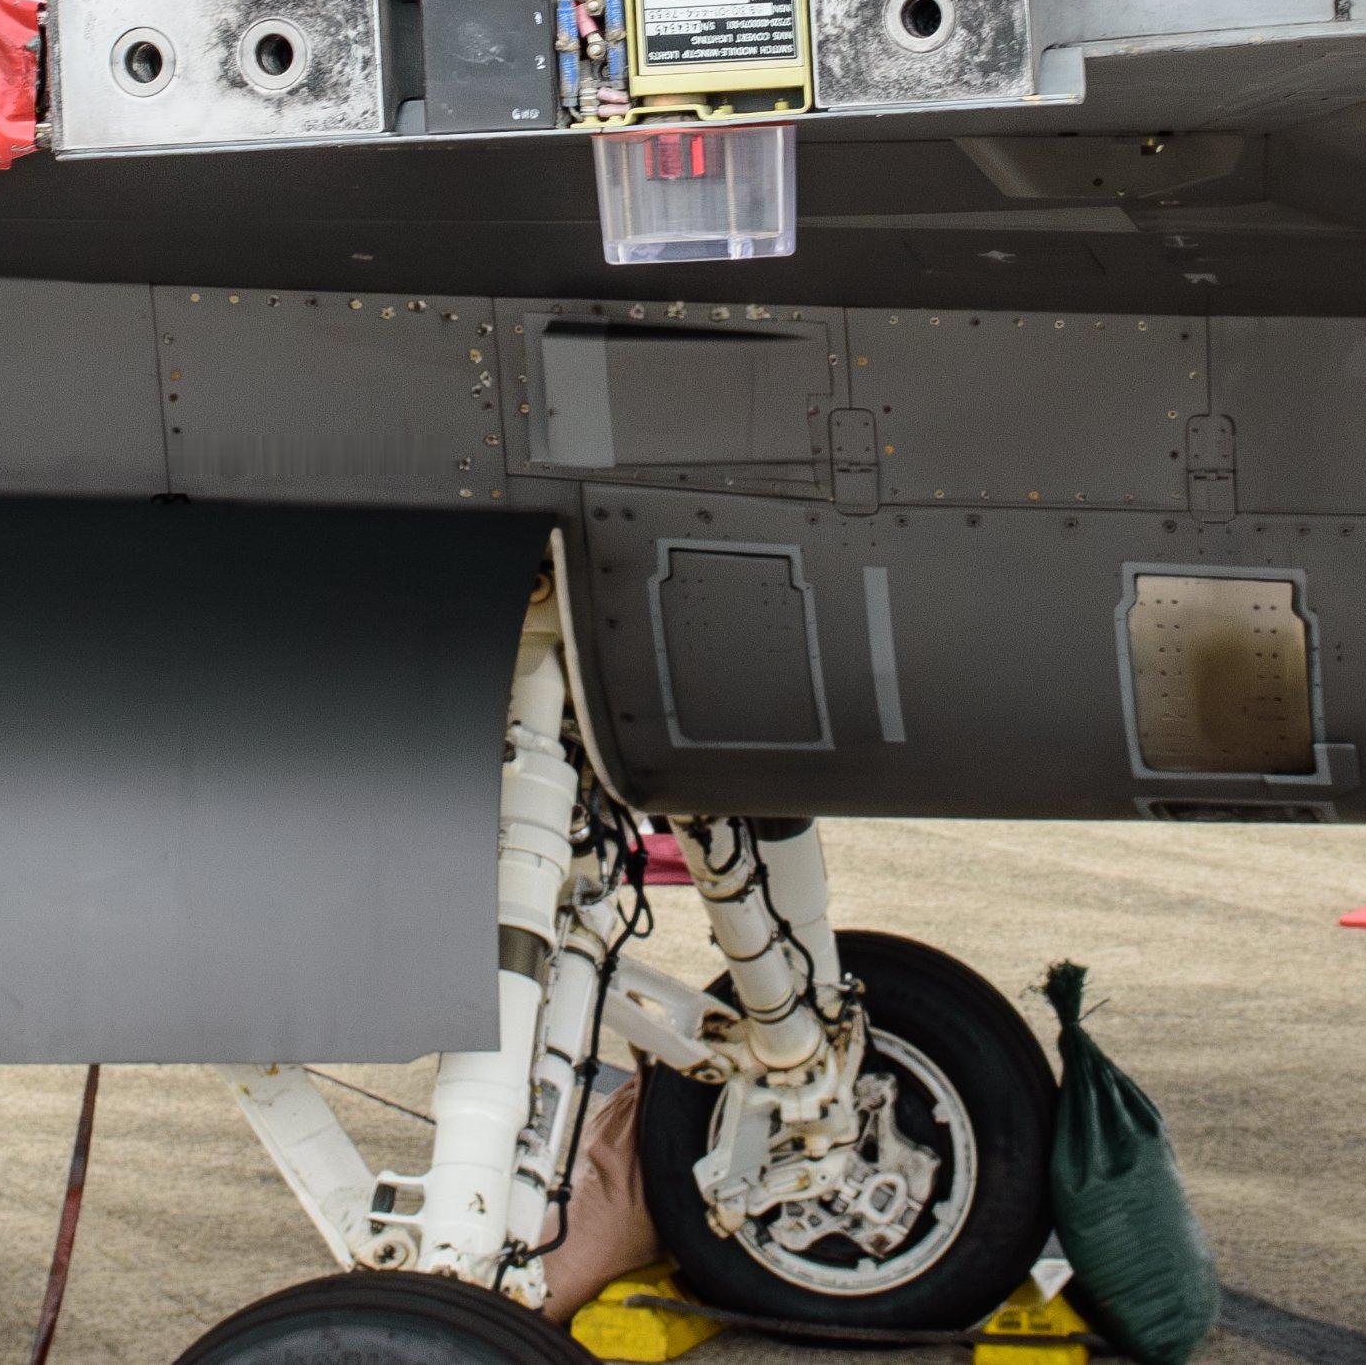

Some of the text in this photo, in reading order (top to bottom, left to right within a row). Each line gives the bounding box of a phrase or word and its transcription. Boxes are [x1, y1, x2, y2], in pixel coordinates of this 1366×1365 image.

[690, 33, 733, 45] LIGHTING
[735, 32, 770, 42] COVERT
[648, 45, 793, 60] SWITCH MODULE-WINGTIP LIGHTS
[534, 55, 547, 70] 2
